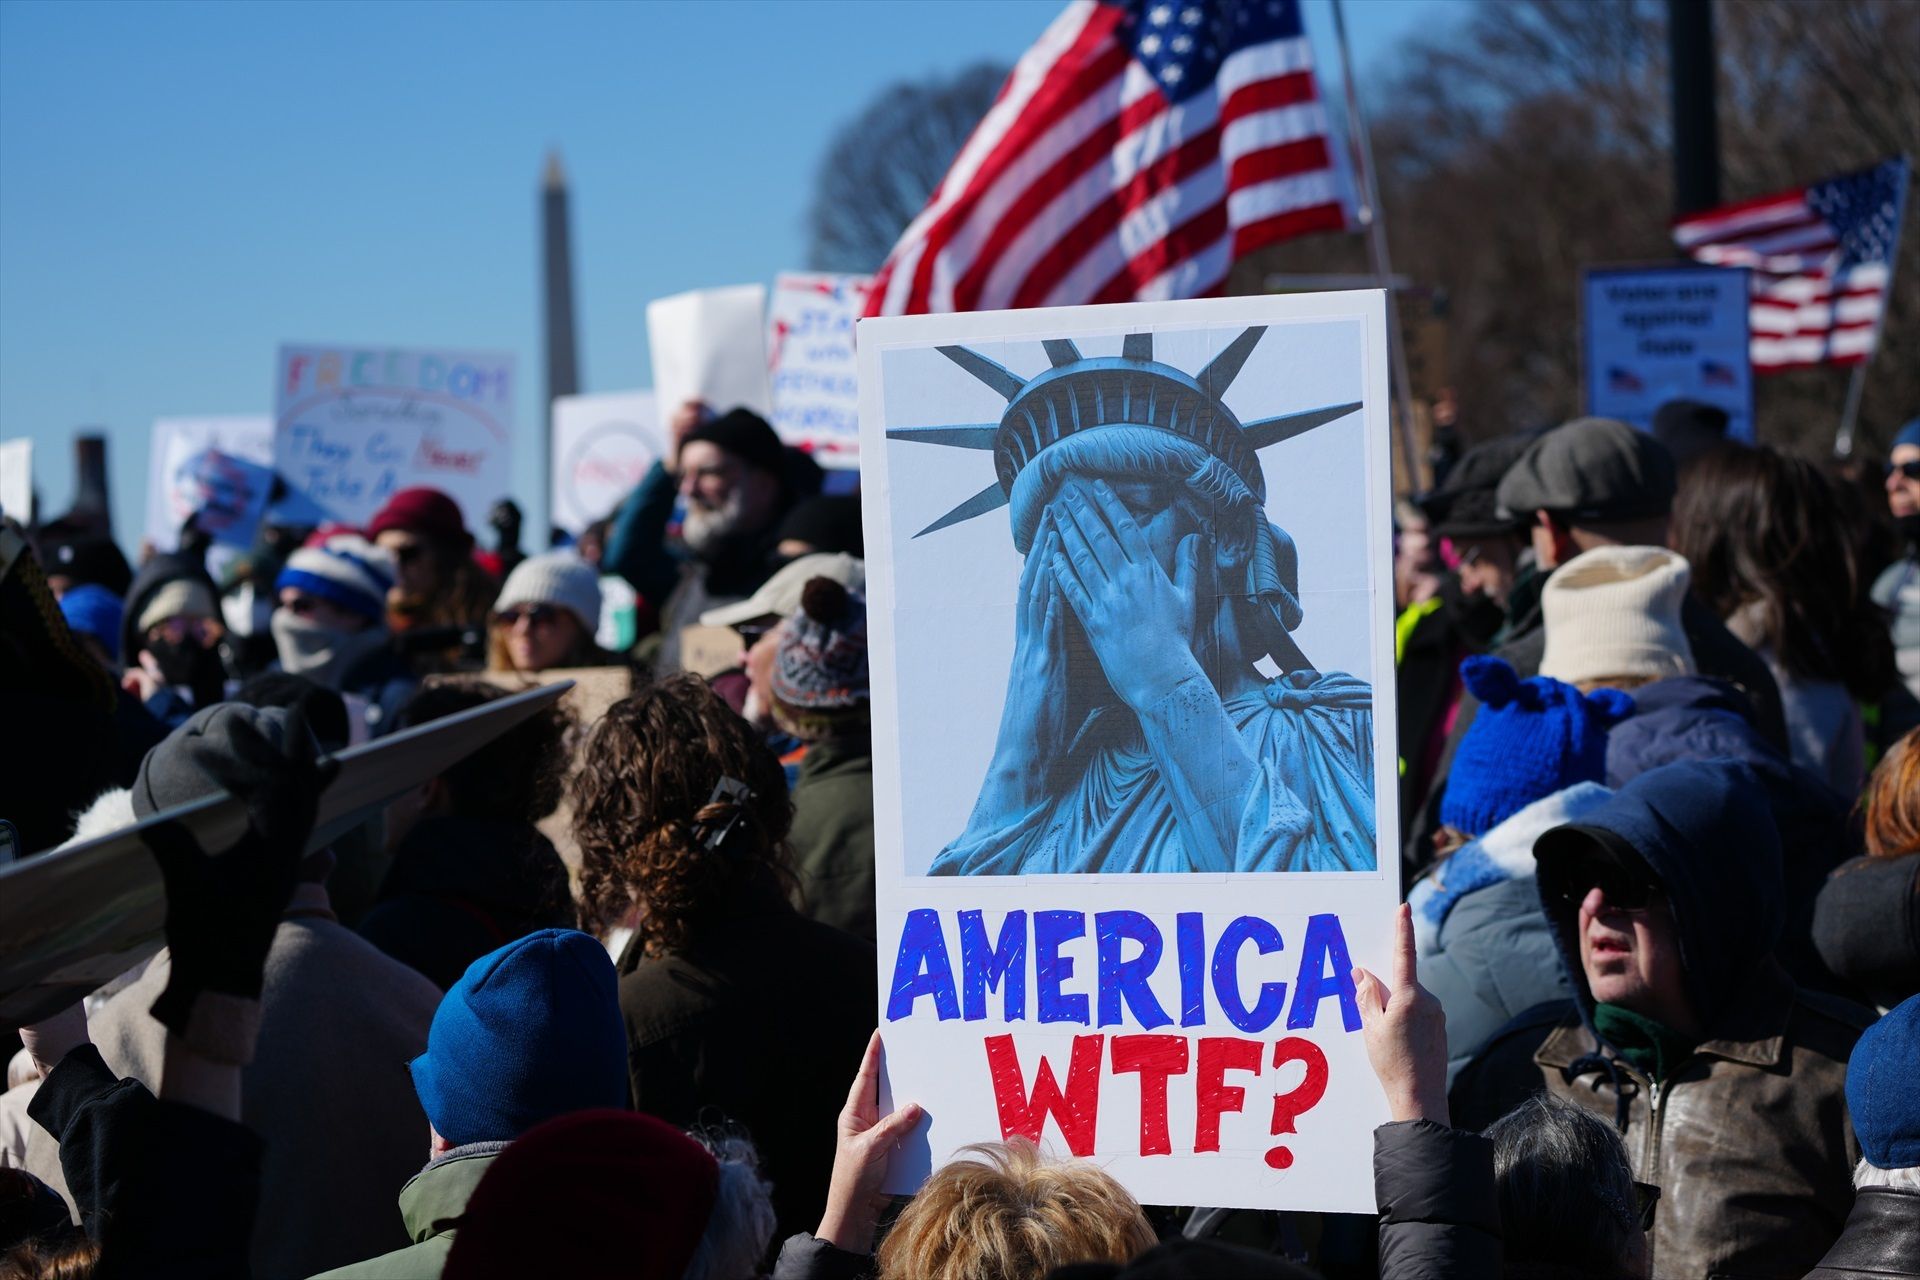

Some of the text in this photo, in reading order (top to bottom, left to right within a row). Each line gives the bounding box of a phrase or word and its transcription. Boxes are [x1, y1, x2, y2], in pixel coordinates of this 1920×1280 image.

[286, 350, 509, 402] FREEDOM
[886, 908, 1363, 1033] AMERICA
[983, 1033, 1329, 1170] WTF?
